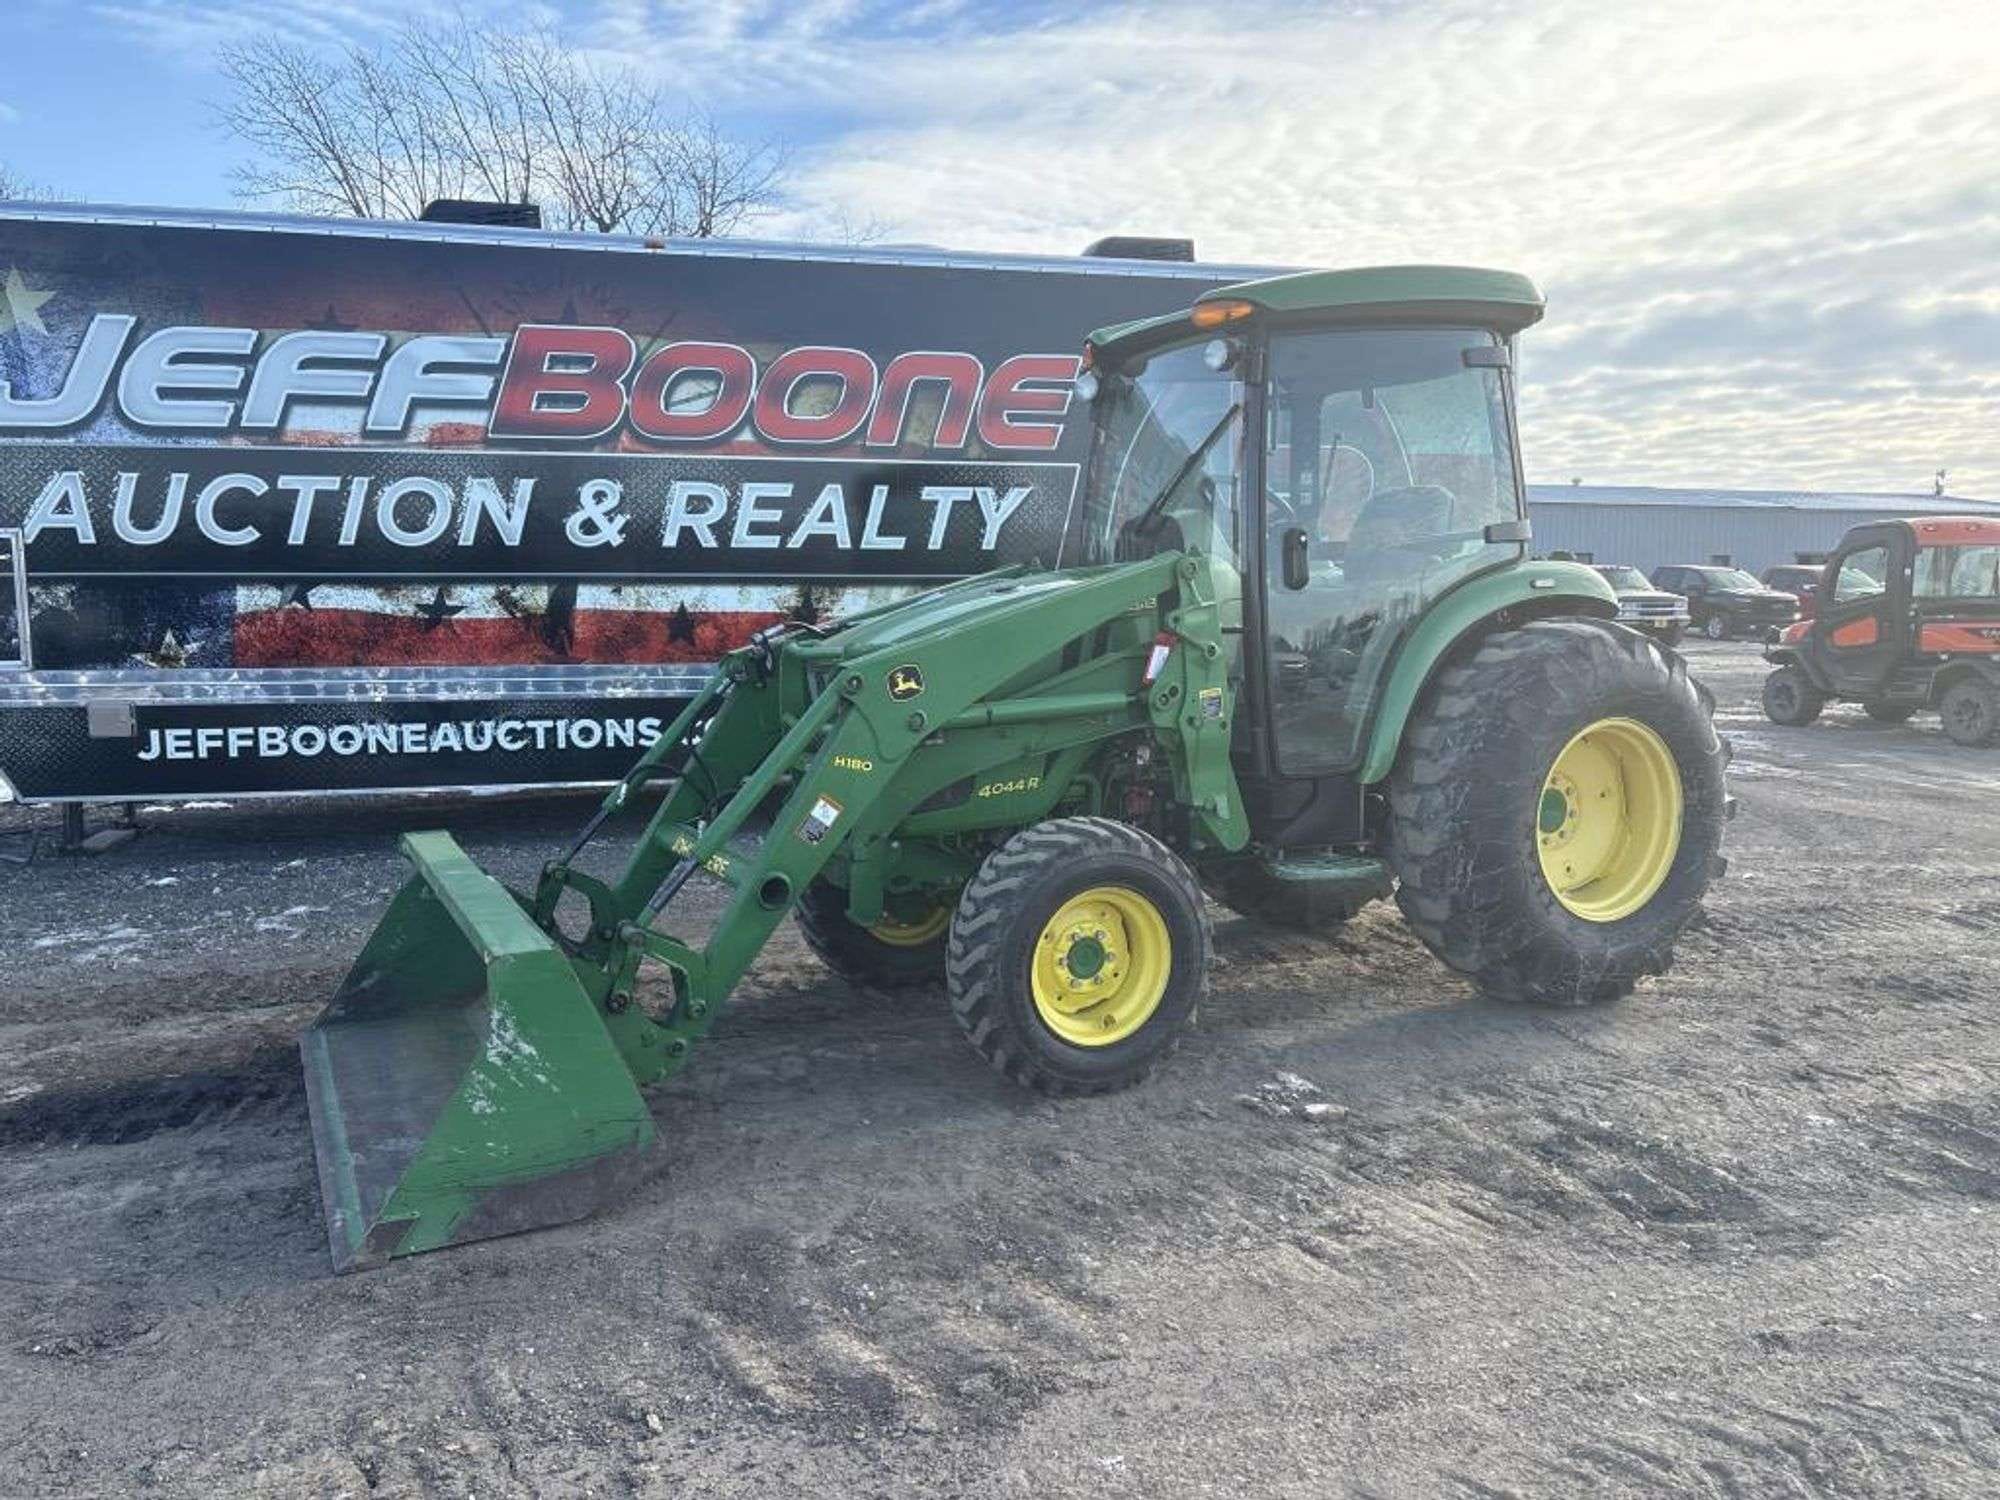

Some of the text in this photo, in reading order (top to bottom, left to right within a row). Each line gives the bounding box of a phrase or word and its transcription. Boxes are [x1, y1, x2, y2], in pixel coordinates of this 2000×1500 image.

[24, 471, 1033, 551] AUCTION & REALTY
[137, 717, 715, 761] JEFFBOONEAUCTIONS
[834, 755, 873, 772] H180
